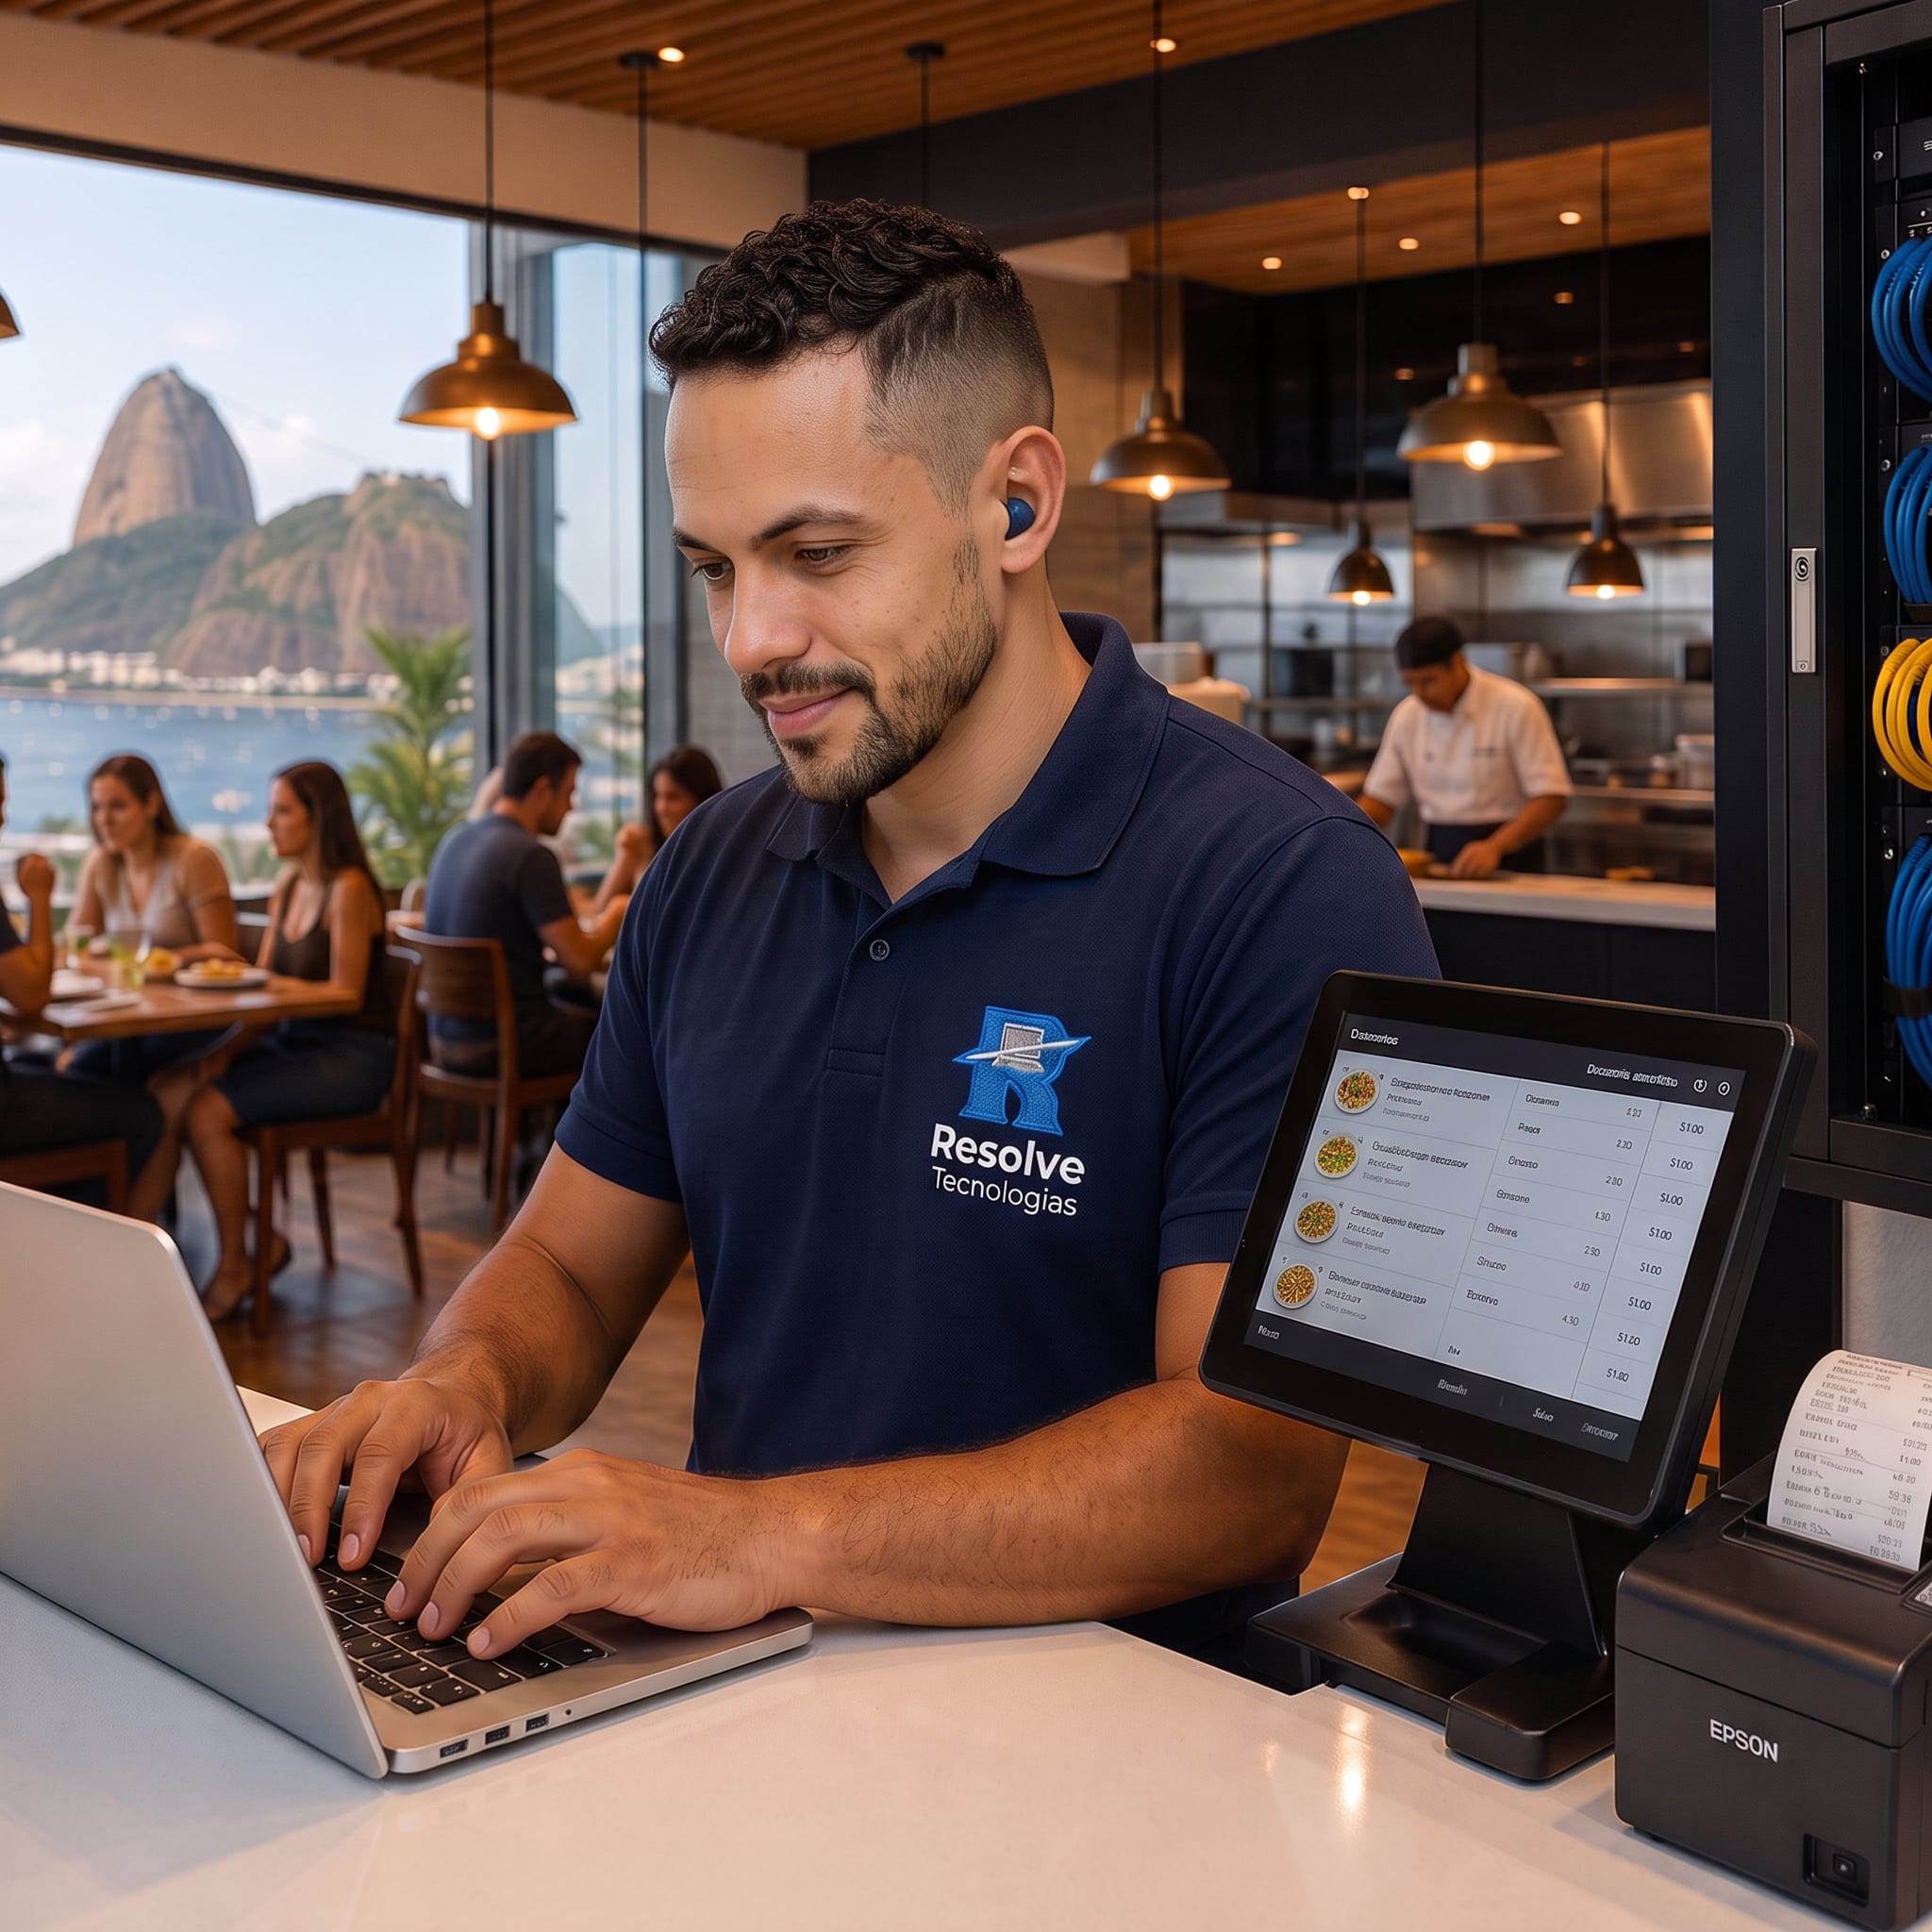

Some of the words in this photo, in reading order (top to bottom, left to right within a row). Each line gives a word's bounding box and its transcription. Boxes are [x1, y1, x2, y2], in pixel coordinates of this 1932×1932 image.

[930, 1123, 1085, 1185] Resolve
[931, 1165, 1077, 1216] Tecnologias
[1710, 1719, 1779, 1764] EPSON
